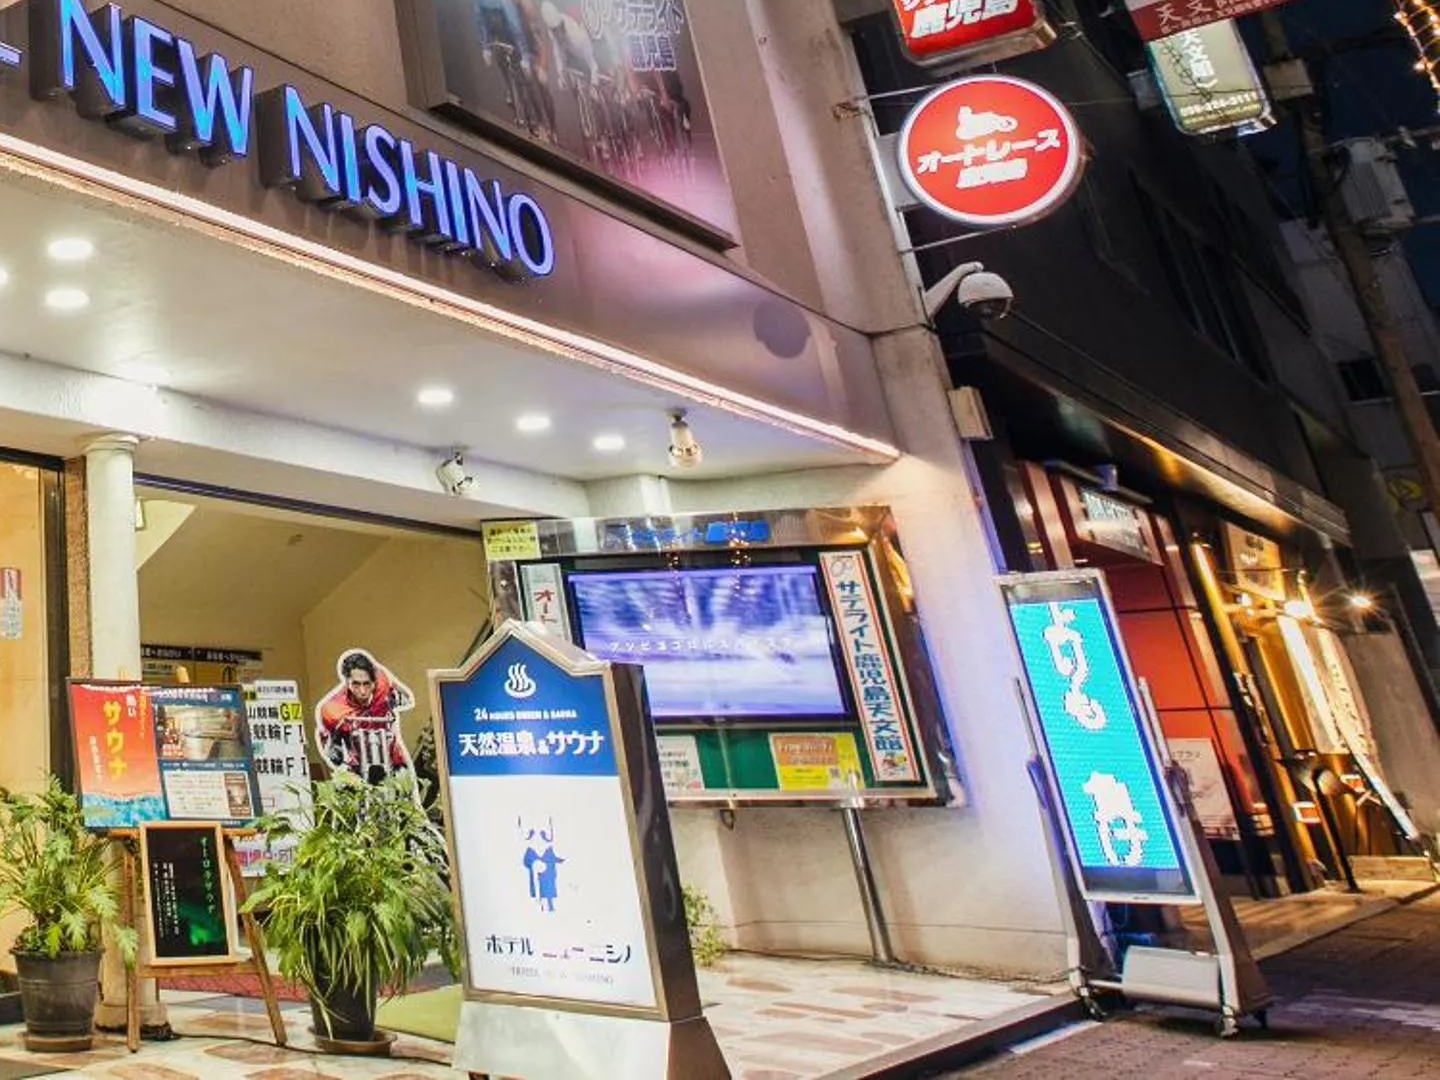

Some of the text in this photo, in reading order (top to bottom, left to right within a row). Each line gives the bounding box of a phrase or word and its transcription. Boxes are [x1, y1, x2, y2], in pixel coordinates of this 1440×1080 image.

[280, 83, 558, 280] NISHINO
[916, 128, 1062, 175] オートレース
[102, 700, 128, 782] サウナ
